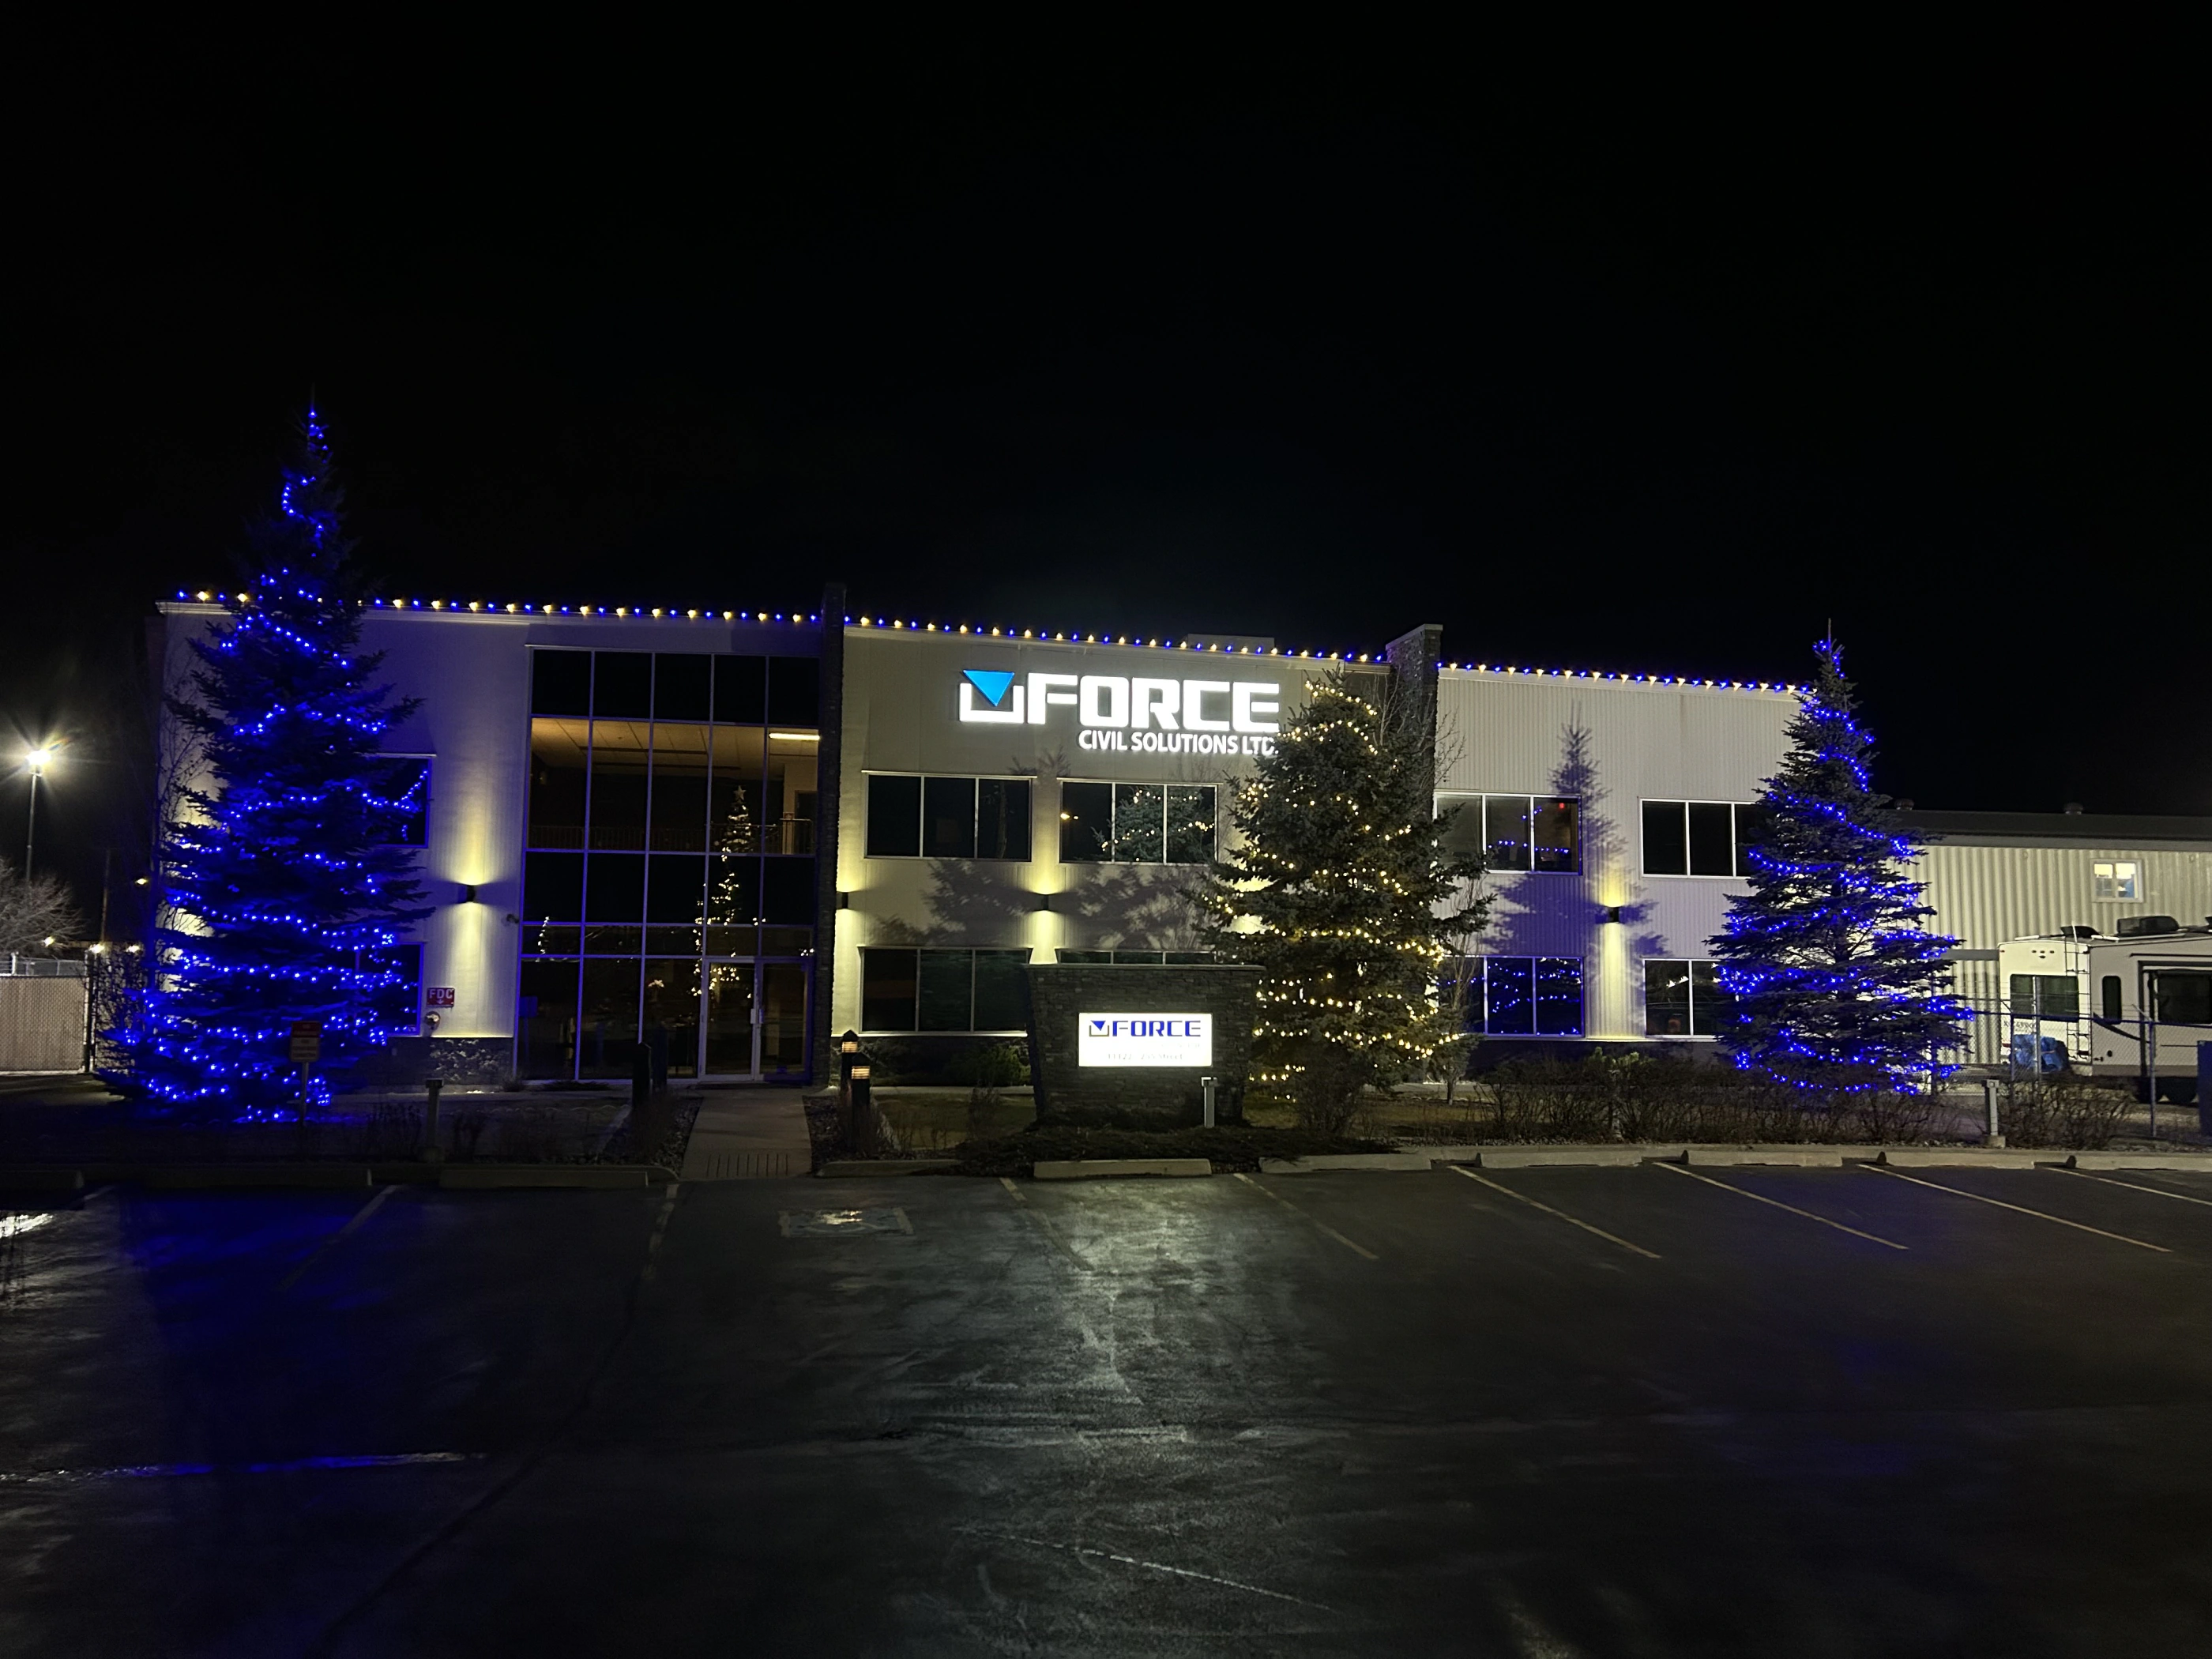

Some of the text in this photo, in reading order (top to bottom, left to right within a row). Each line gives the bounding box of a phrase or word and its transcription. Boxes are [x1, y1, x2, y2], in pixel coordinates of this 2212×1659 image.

[1027, 672, 1280, 732] FORCE
[1078, 729, 1128, 751] CIVIL
[1130, 731, 1239, 755] SOLUTIONS
[429, 988, 453, 999] FDC
[1112, 1020, 1201, 1036] FORCE
